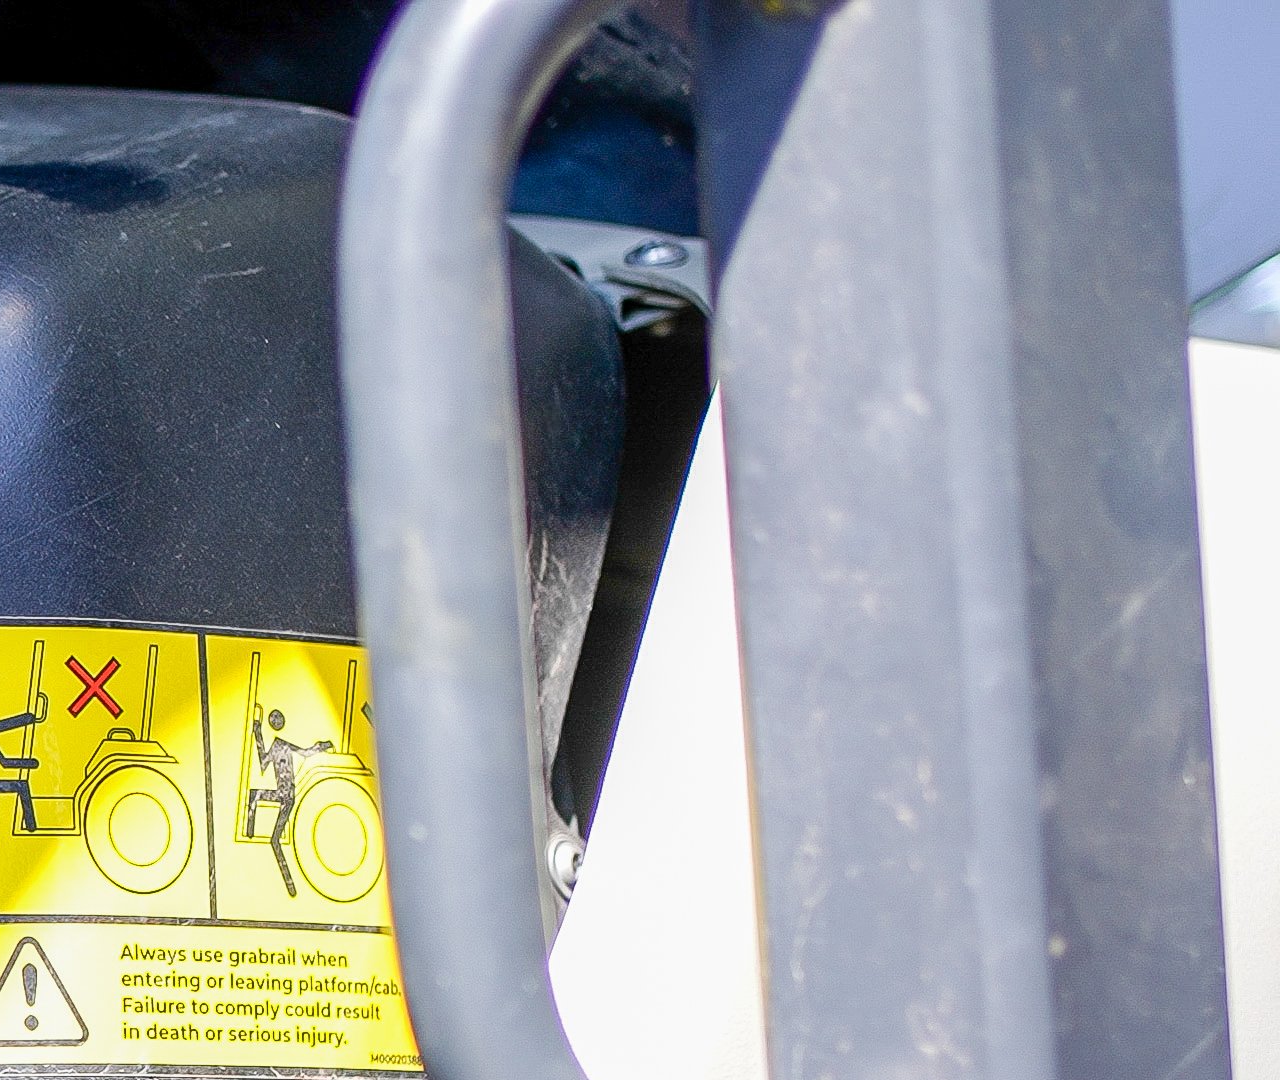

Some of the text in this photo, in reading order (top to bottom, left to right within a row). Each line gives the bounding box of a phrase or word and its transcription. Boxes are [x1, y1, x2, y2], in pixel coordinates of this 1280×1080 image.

[120, 943, 348, 968] Always use grabrail when
[121, 970, 402, 997] entering or leaving platform/cab.
[122, 996, 381, 1021] Failure to comply could result
[123, 1022, 348, 1049] in death or serious injury.
